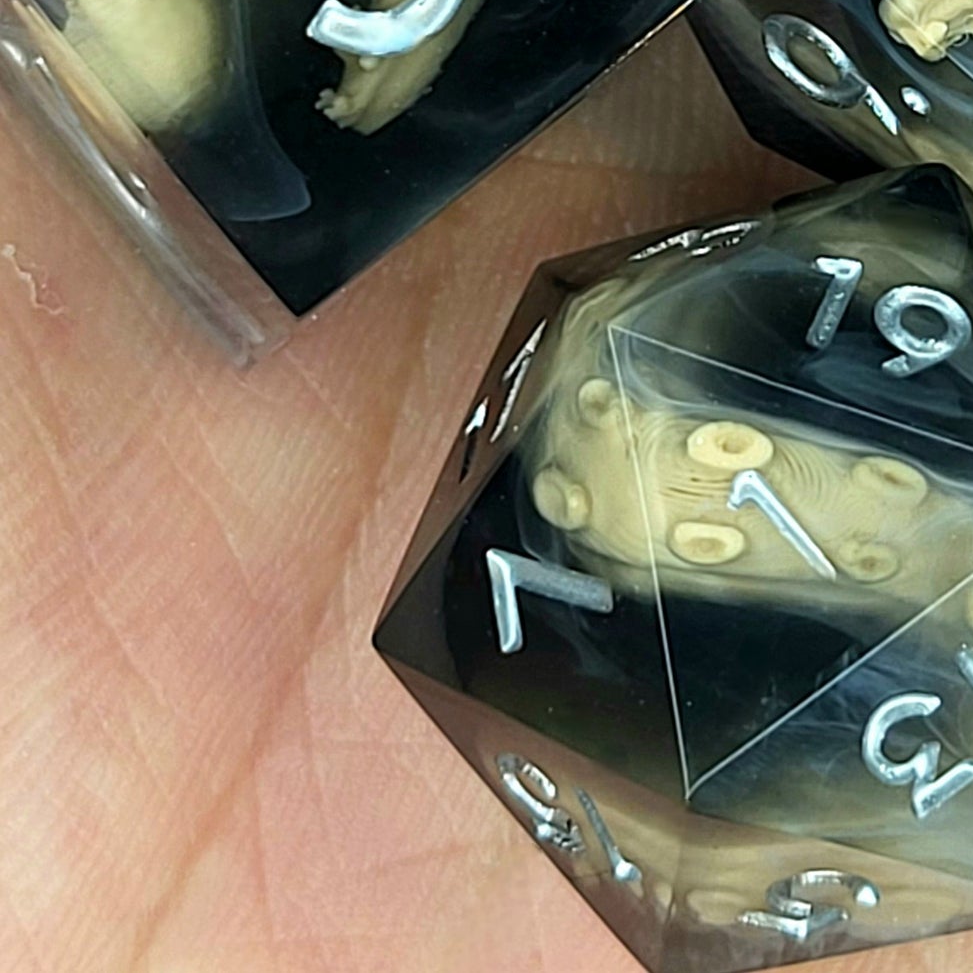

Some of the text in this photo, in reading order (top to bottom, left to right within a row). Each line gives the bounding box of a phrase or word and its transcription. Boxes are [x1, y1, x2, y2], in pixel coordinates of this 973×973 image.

[806, 255, 973, 379] 19
[727, 469, 838, 580] 1
[486, 548, 614, 654] 7
[738, 869, 881, 941] 5
